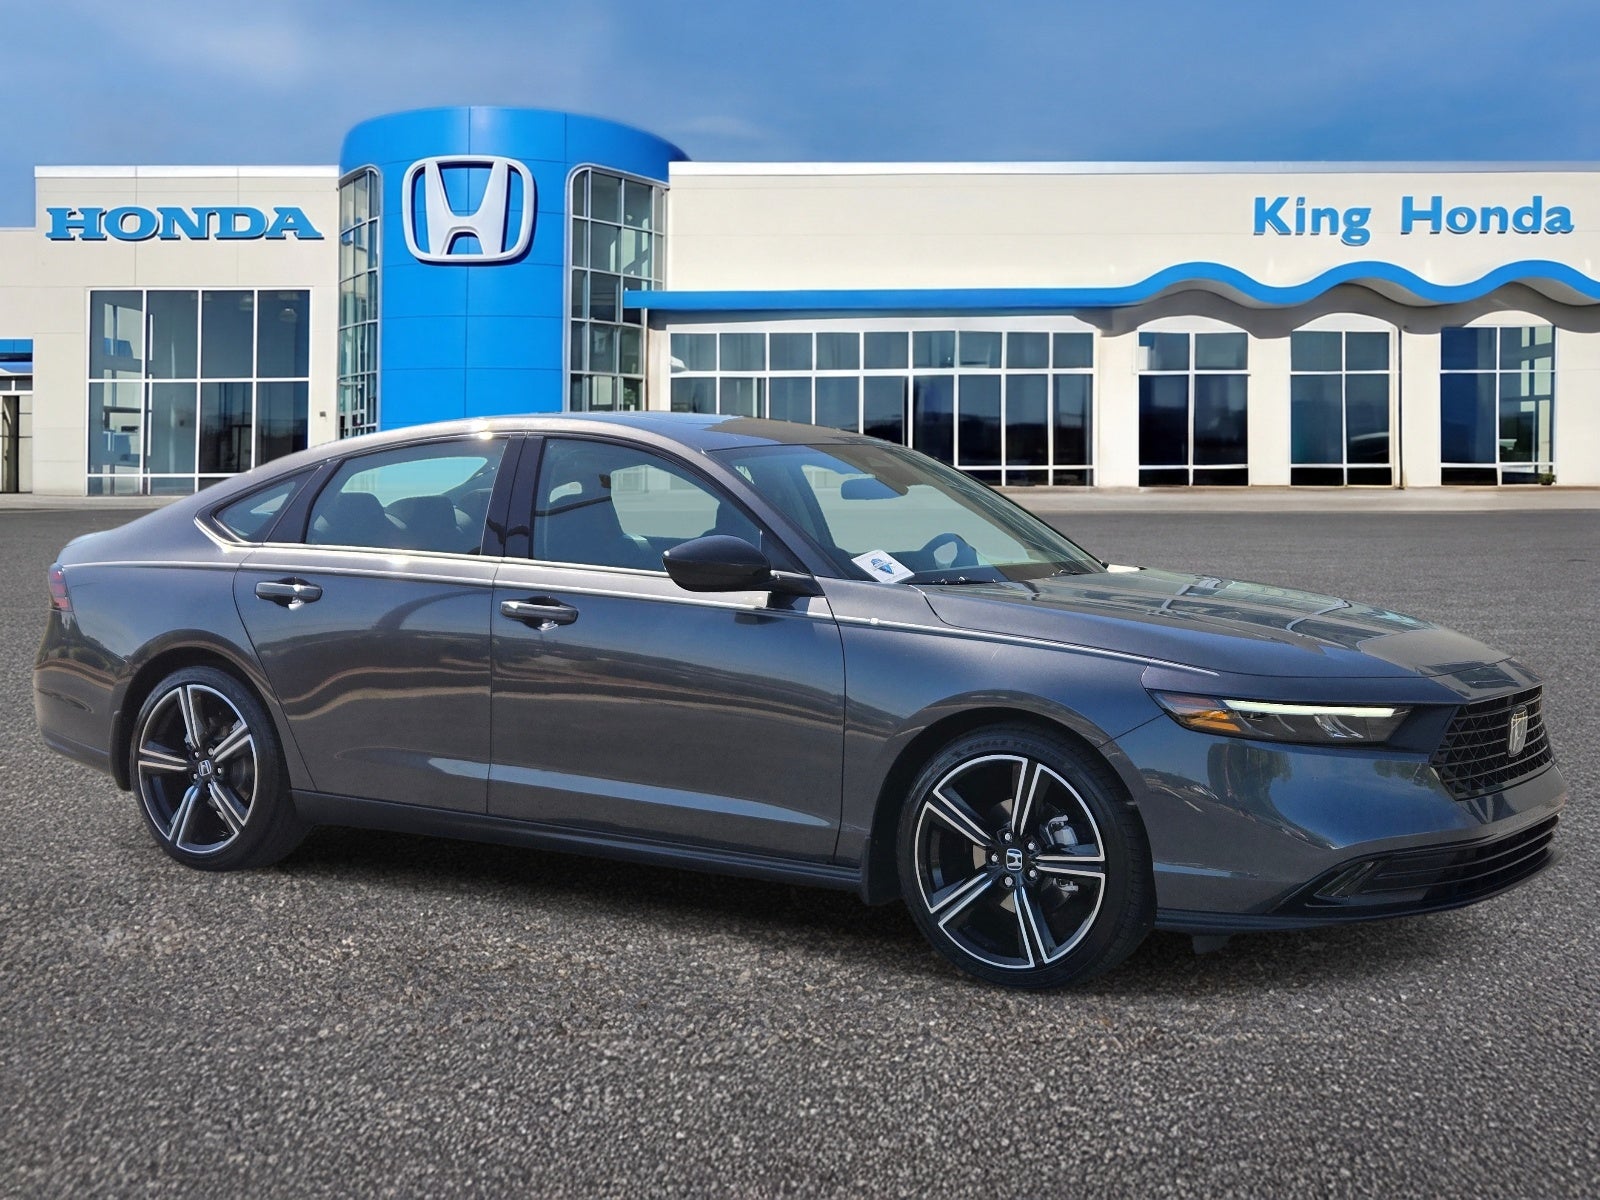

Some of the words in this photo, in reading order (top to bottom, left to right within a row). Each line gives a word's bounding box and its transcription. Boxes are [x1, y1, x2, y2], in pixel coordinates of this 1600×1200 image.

[46, 206, 325, 241] HONDA
[1253, 196, 1372, 246] King
[1400, 195, 1575, 235] Honda
